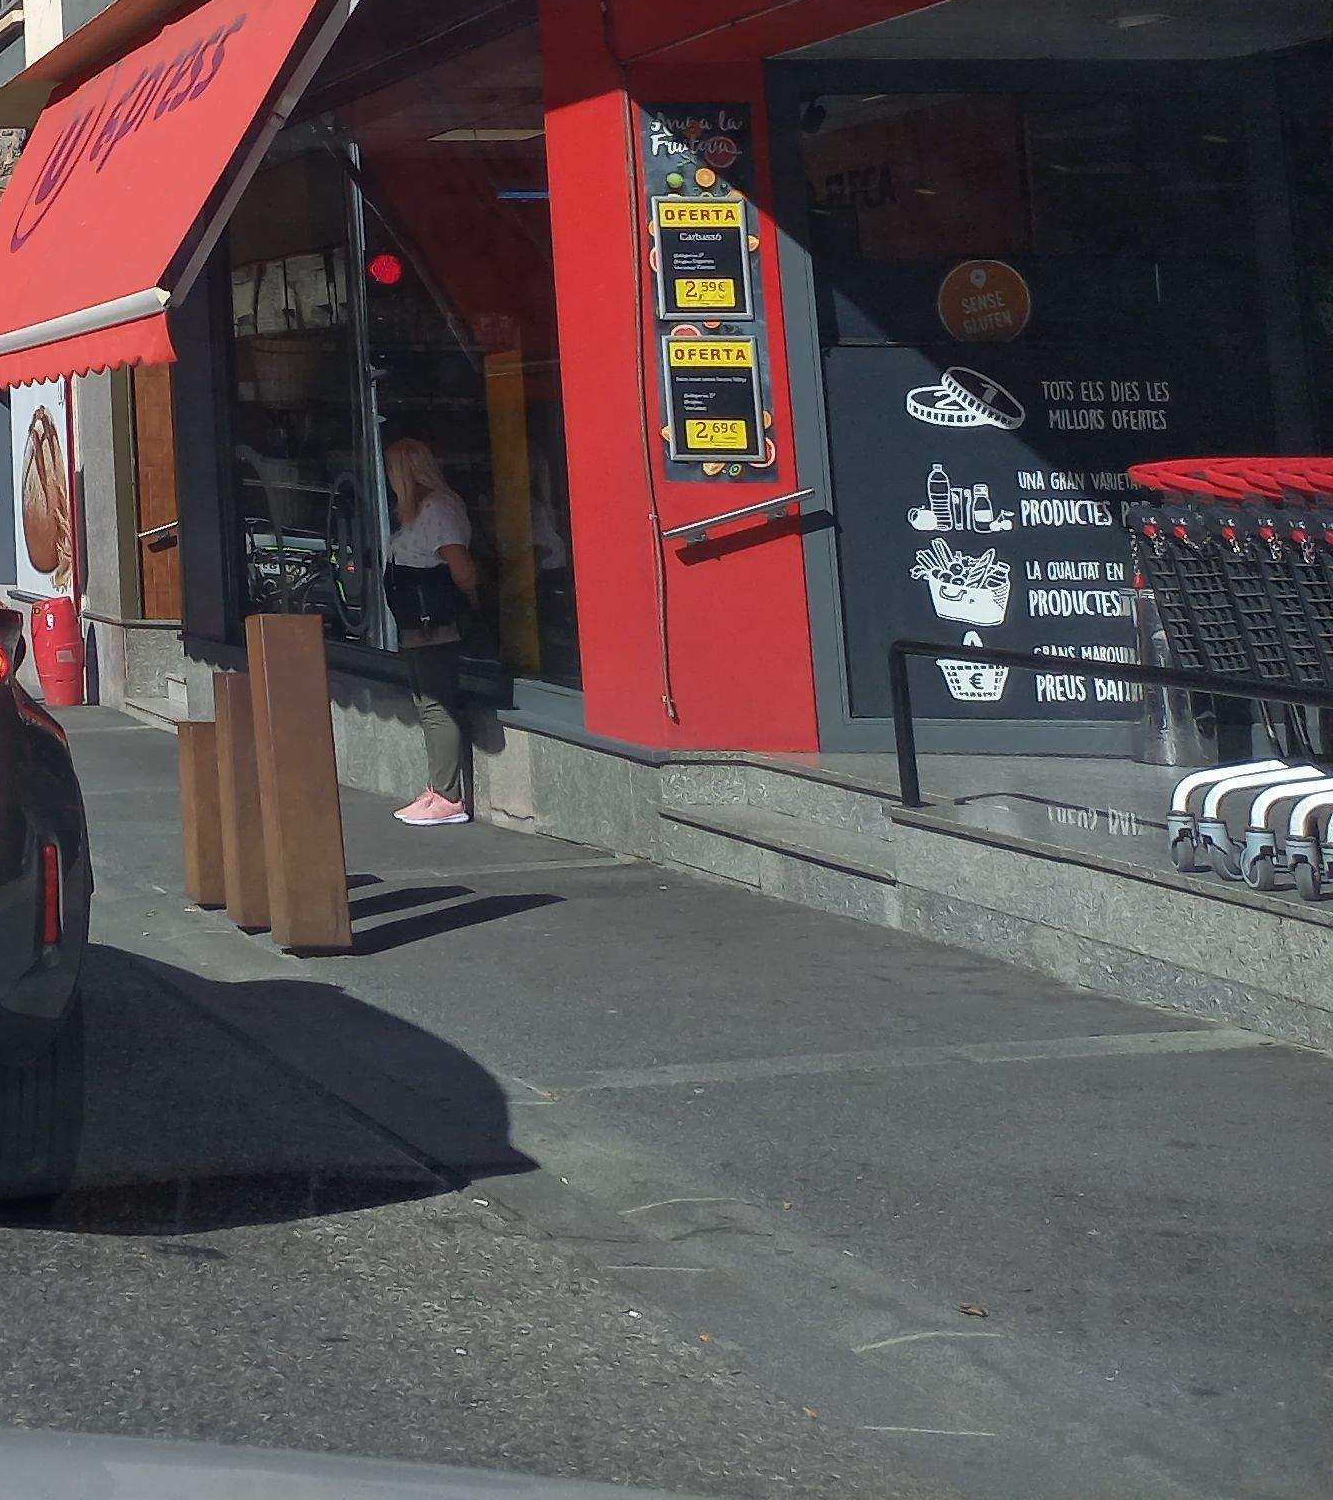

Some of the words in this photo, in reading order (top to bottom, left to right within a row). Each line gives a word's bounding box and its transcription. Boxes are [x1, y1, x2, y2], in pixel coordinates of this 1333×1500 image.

[664, 209, 736, 221] OFERTA
[674, 348, 747, 361] OFERTA
[1041, 380, 1074, 401] TOTS
[1080, 380, 1105, 401] ELS
[1110, 380, 1141, 402] DIES
[1145, 381, 1170, 402] LES
[1048, 408, 1106, 430] MILLORS
[1112, 409, 1167, 430] OFERTES
[1018, 471, 1045, 490] UNA
[1050, 472, 1084, 491] GRAN
[1020, 500, 1113, 527] PRODUCTES
[1026, 561, 1042, 580] LA
[1047, 561, 1100, 580] QUALITAT
[1105, 562, 1124, 580] EN
[1028, 589, 1121, 617] PRODUCTES
[1035, 674, 1086, 702] PREUS
